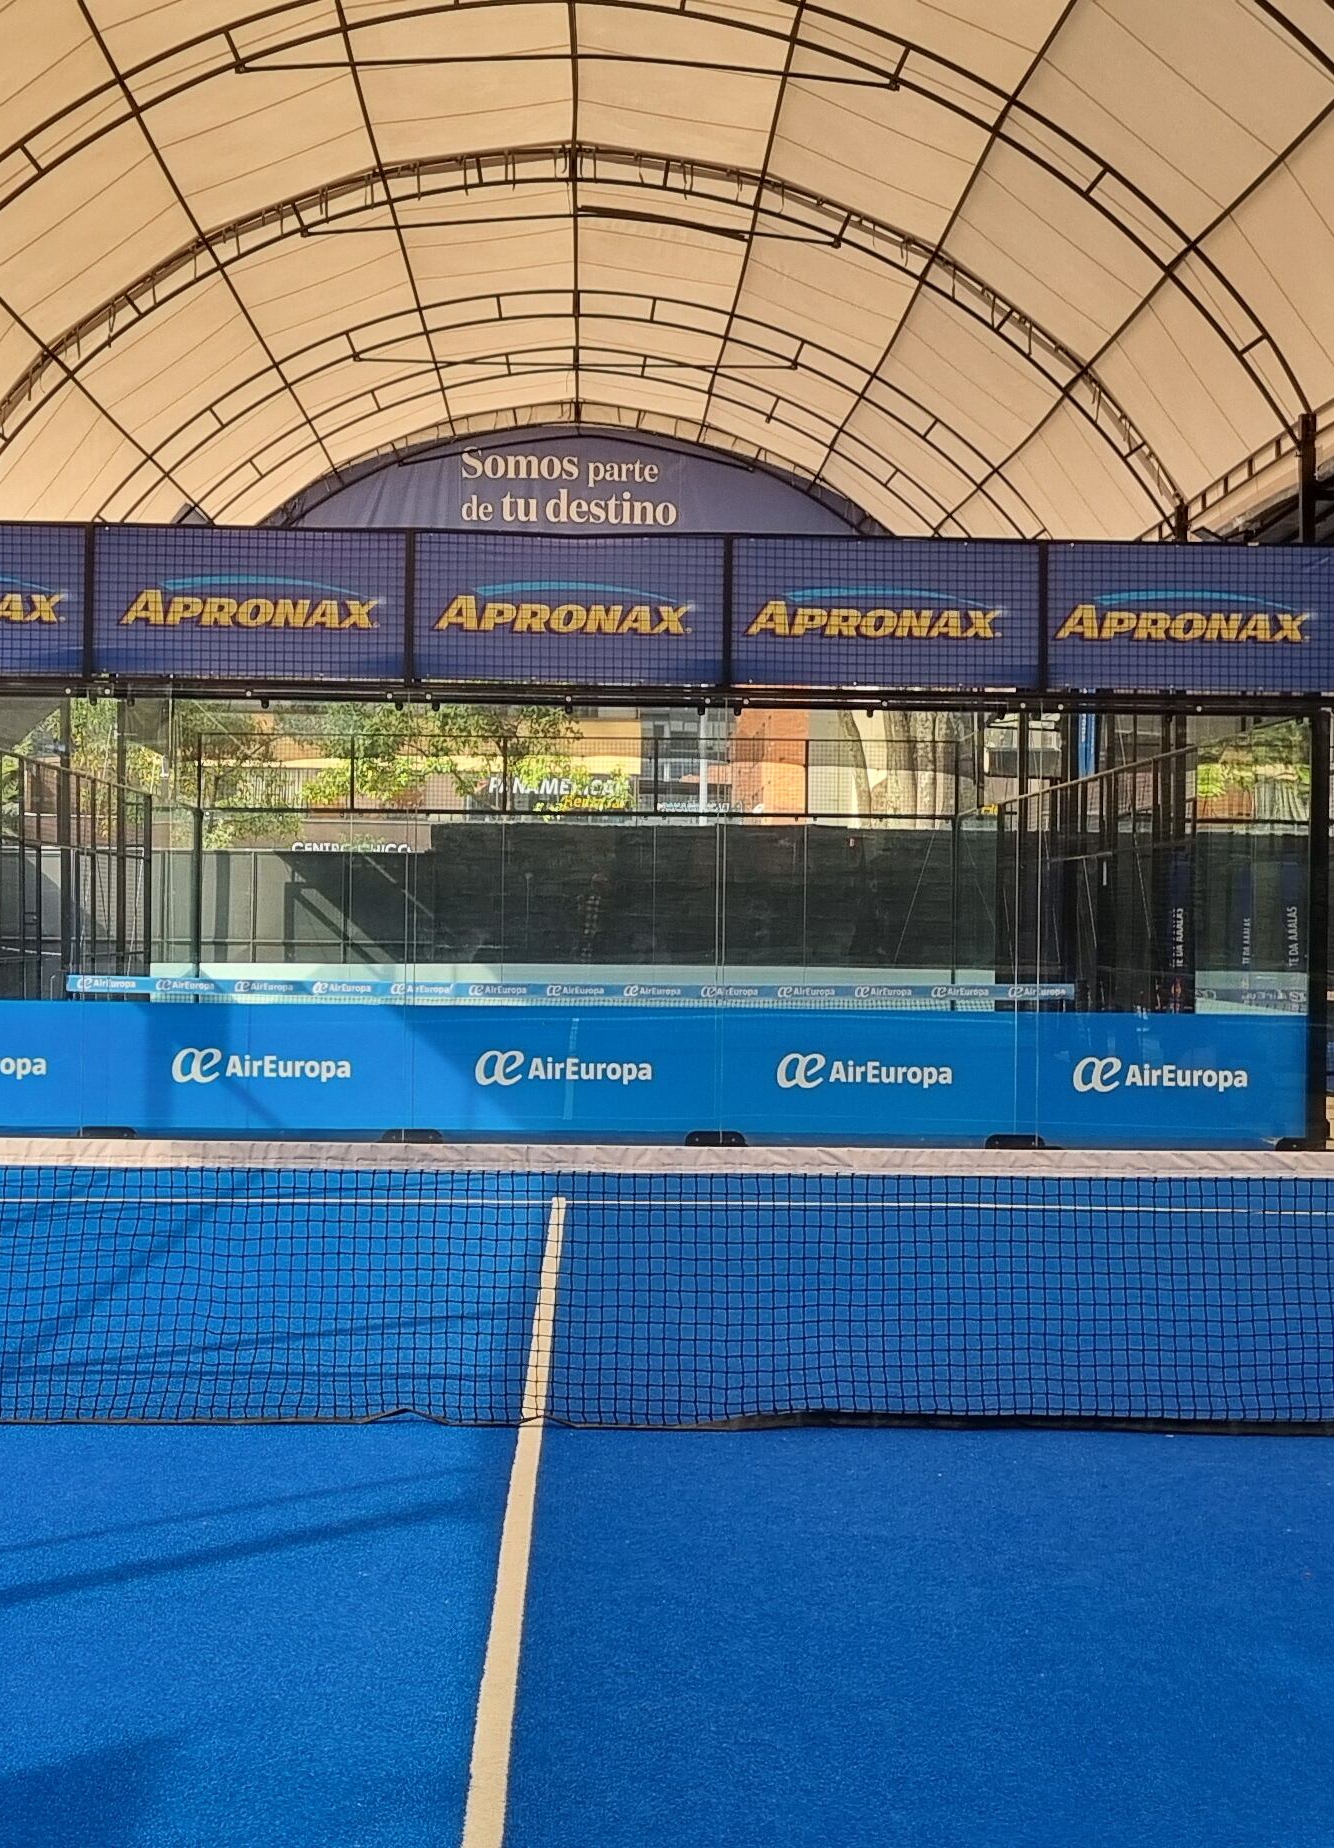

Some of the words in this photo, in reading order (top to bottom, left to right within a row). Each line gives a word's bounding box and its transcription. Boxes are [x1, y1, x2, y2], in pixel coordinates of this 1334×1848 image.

[461, 446, 579, 480] Somos
[588, 459, 659, 487] parte
[461, 494, 493, 521] de
[501, 491, 538, 522] tu
[545, 488, 677, 526] destino
[120, 588, 381, 630] APRONAX
[431, 594, 694, 635] APRONAX
[745, 600, 1002, 640] APRONAX
[1055, 604, 1311, 644] APRONAX
[225, 1054, 351, 1082] AirEuropa
[528, 1056, 652, 1085] AirEuropa
[829, 1059, 953, 1087] AirEuropa
[1125, 1063, 1248, 1092] AirEuropa
